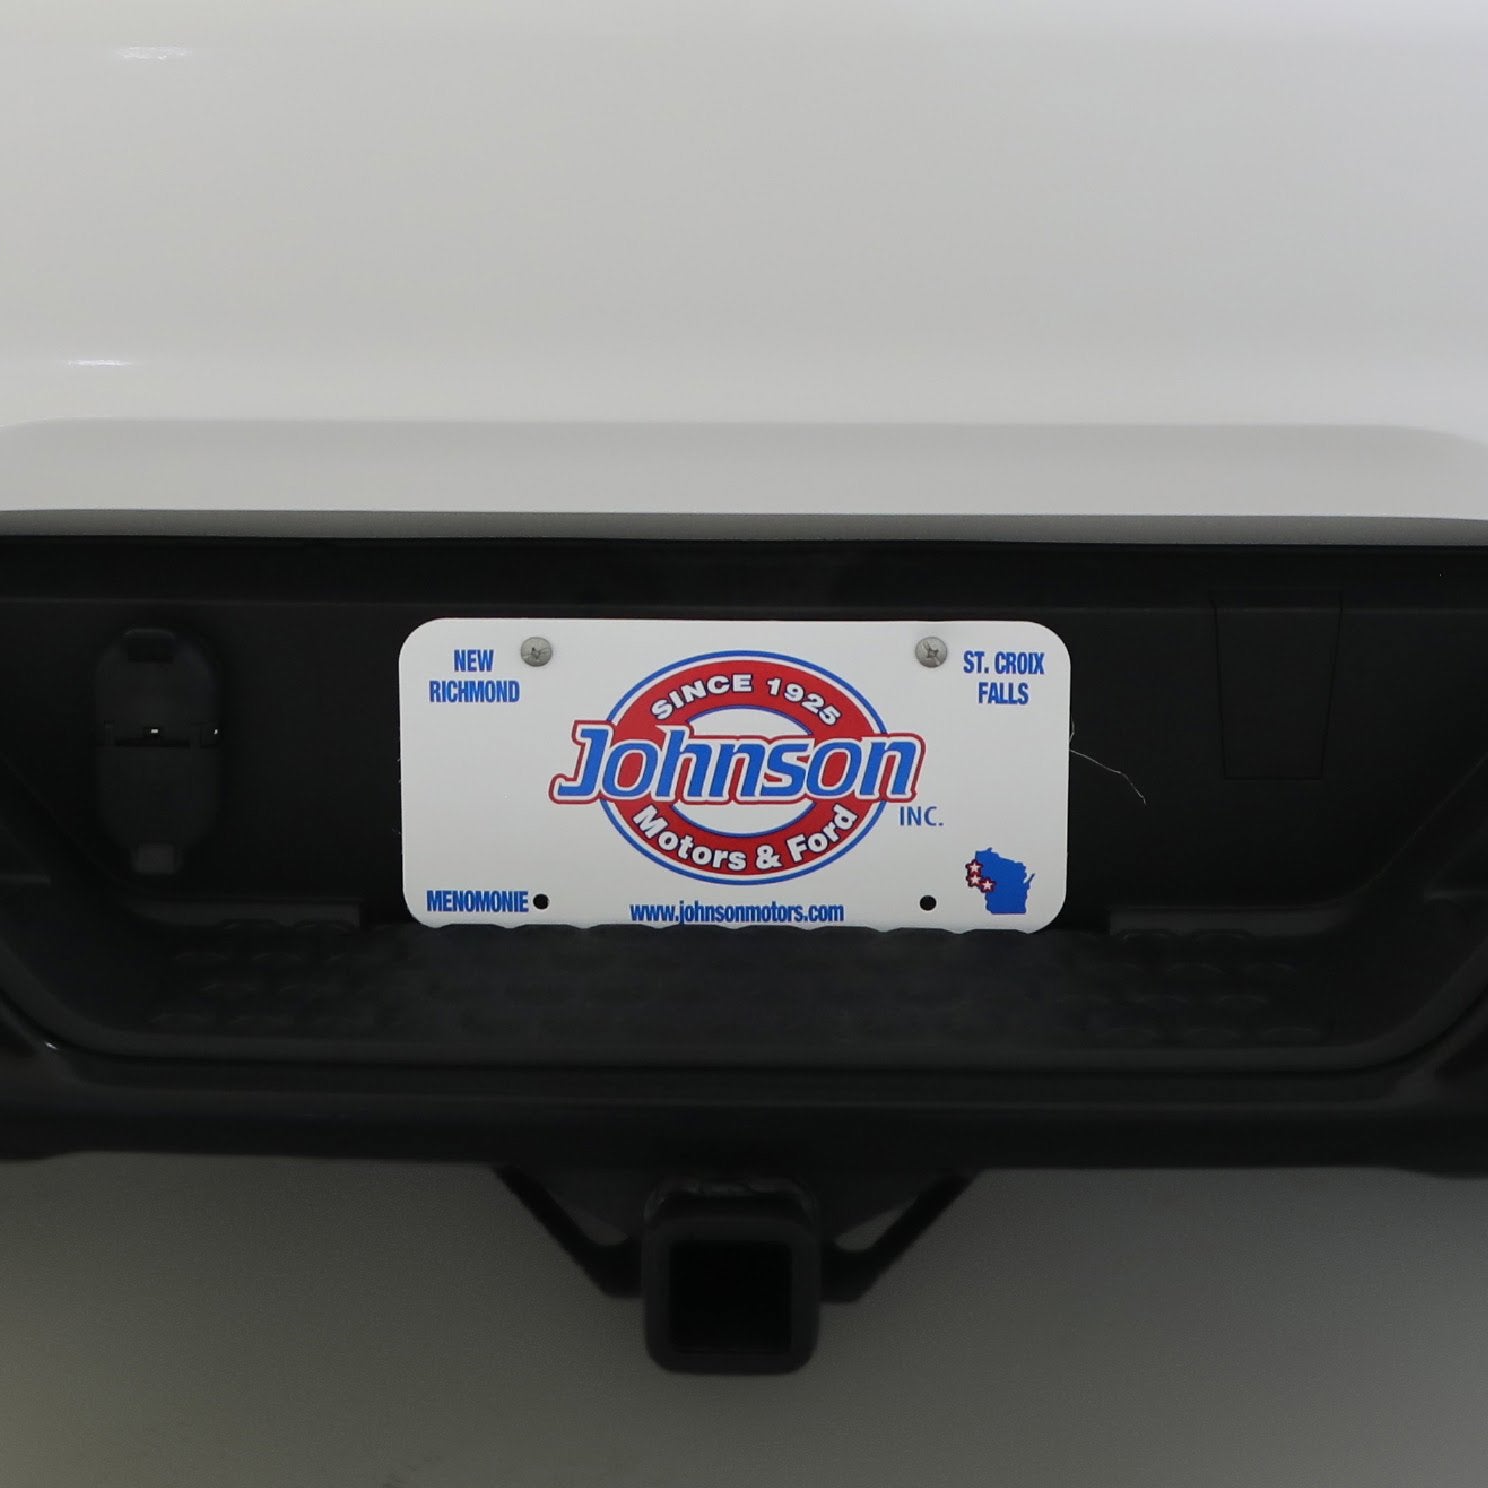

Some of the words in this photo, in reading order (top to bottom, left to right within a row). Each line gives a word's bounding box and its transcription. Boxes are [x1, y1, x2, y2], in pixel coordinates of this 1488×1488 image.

[453, 648, 494, 673] NEW
[962, 651, 990, 675] ST.
[994, 651, 1045, 675] CROIX
[428, 679, 521, 704] RICHMOND
[649, 673, 753, 721] SINCE
[766, 676, 840, 727] 1925
[977, 681, 1029, 705] FALLS
[552, 721, 923, 802] Johnson
[898, 805, 945, 827] INC.
[632, 805, 748, 871] Motors
[755, 844, 782, 871] &
[786, 804, 858, 863] Ford
[425, 889, 529, 913] MENOMONIE
[629, 900, 845, 925] www.johnsonmotors.com
